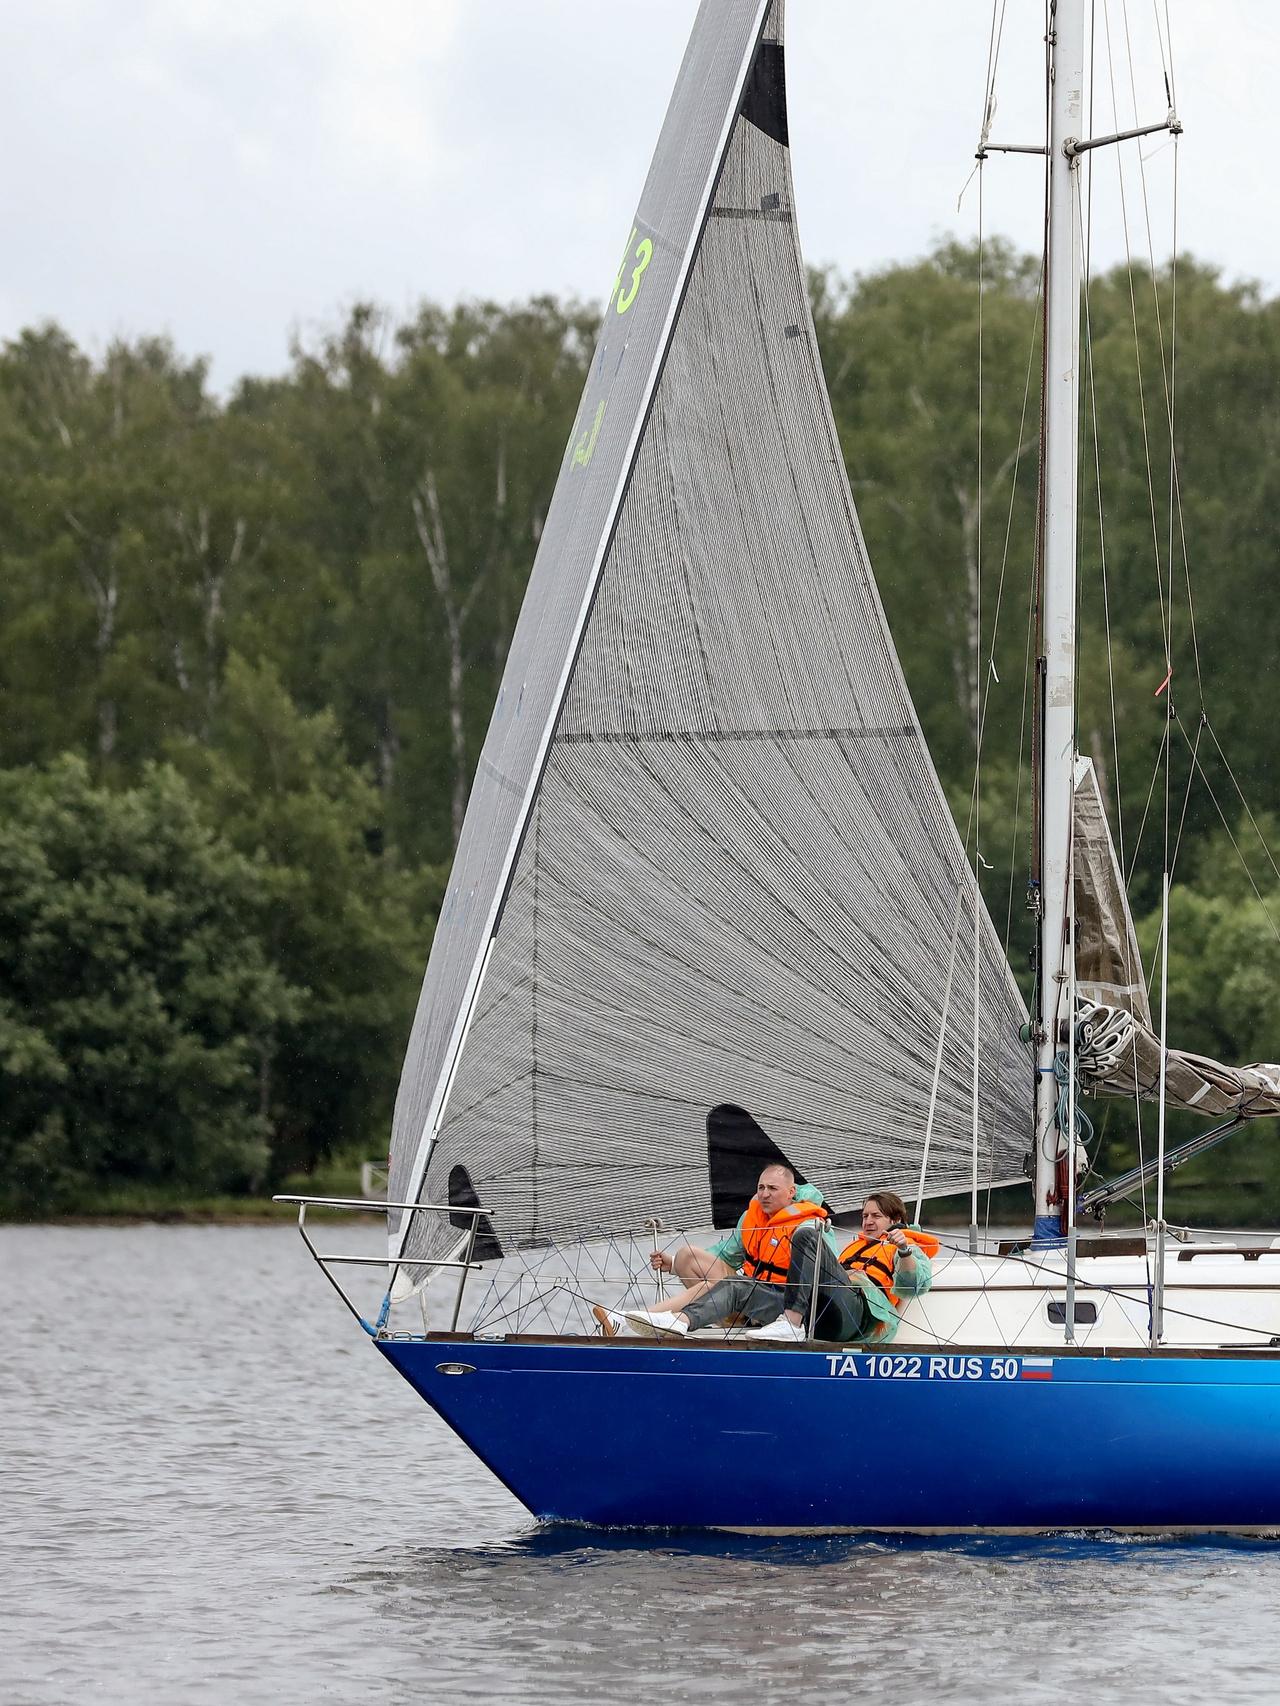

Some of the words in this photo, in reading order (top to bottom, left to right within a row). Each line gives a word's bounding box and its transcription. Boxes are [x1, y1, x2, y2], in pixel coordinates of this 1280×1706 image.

[826, 1355, 859, 1377] TA
[865, 1356, 922, 1378] 1022
[928, 1357, 983, 1379] RUS
[990, 1358, 1019, 1380] 50
